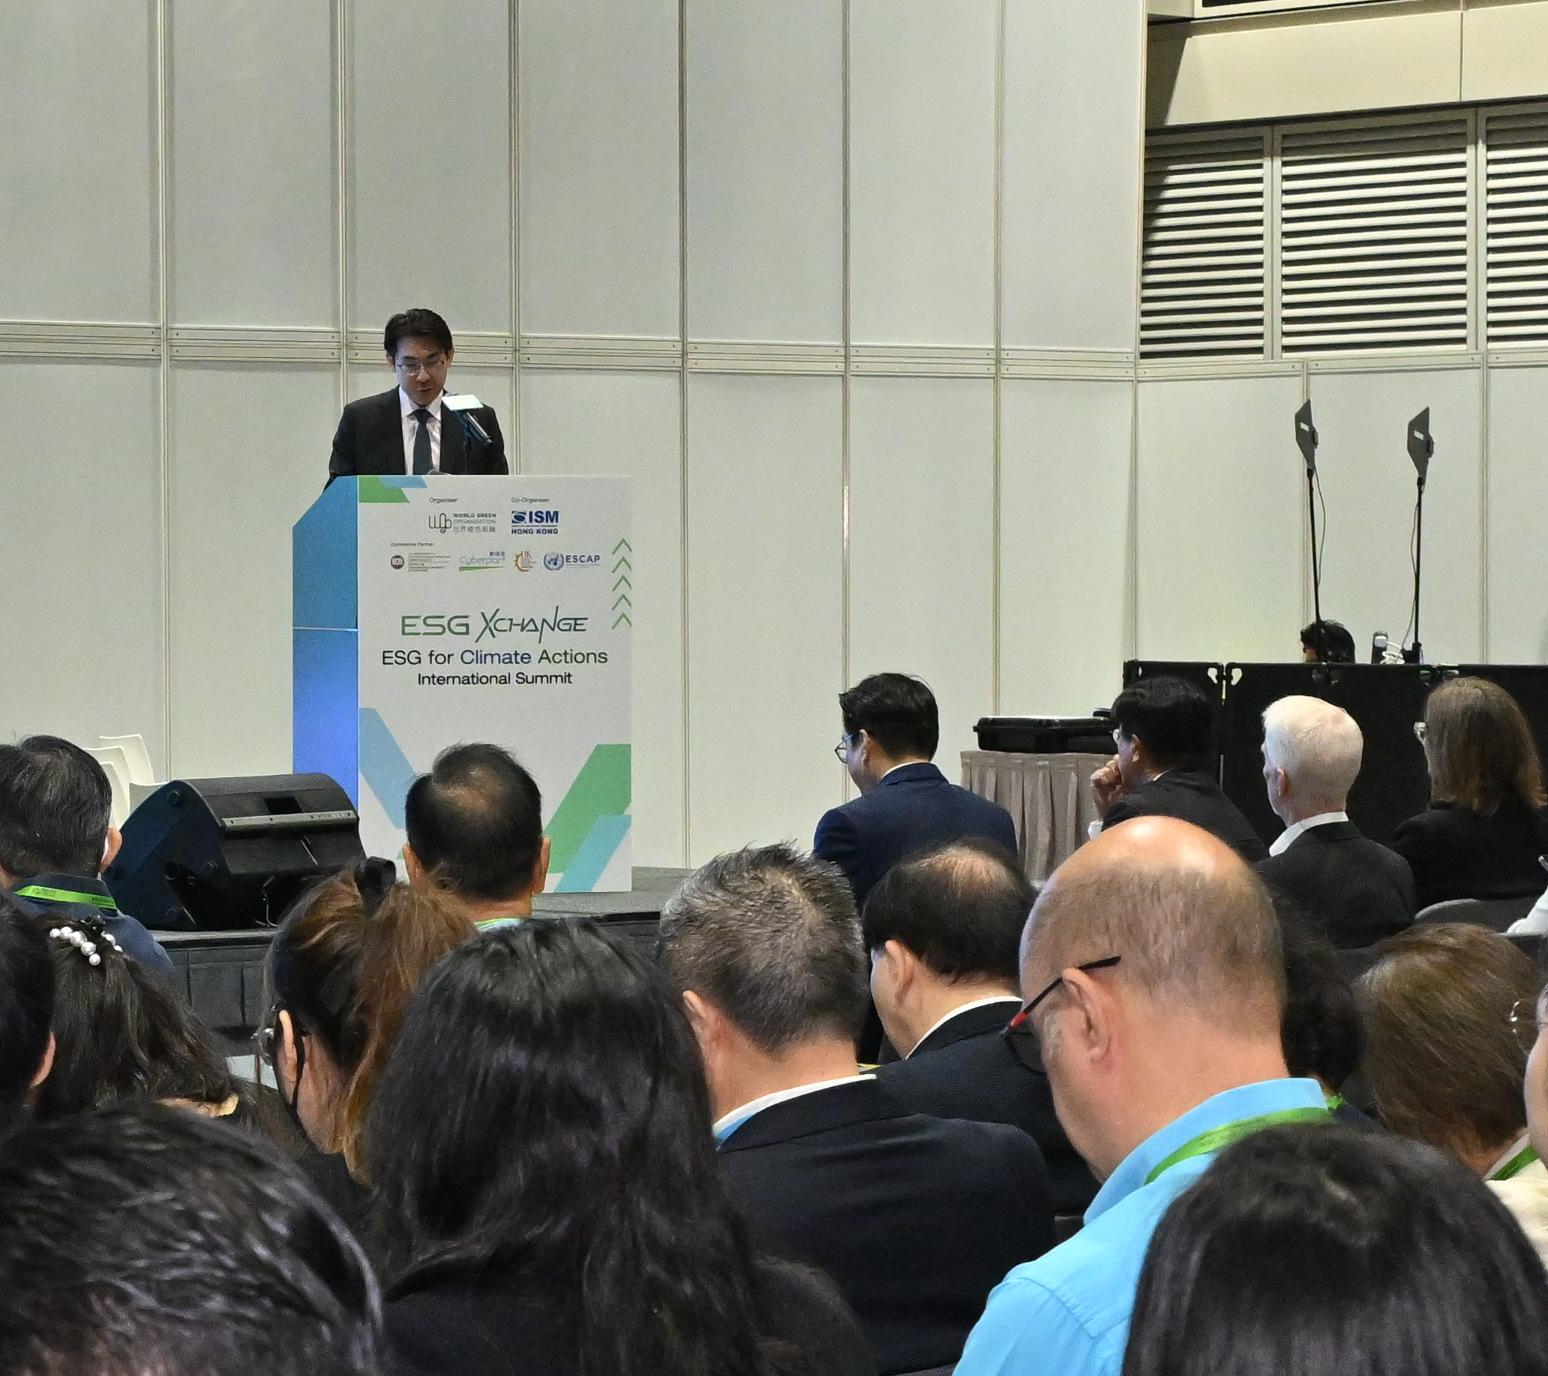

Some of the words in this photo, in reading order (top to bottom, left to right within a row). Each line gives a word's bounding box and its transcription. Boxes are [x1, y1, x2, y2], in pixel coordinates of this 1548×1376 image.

[528, 510, 560, 524] ISM
[565, 554, 601, 564] ESCAP
[401, 614, 470, 636] ESG
[381, 650, 422, 666] ESG
[428, 649, 455, 666] for
[460, 649, 533, 666] Climate
[538, 649, 608, 665] Actions
[417, 672, 511, 686] International
[515, 672, 573, 686] Summit
